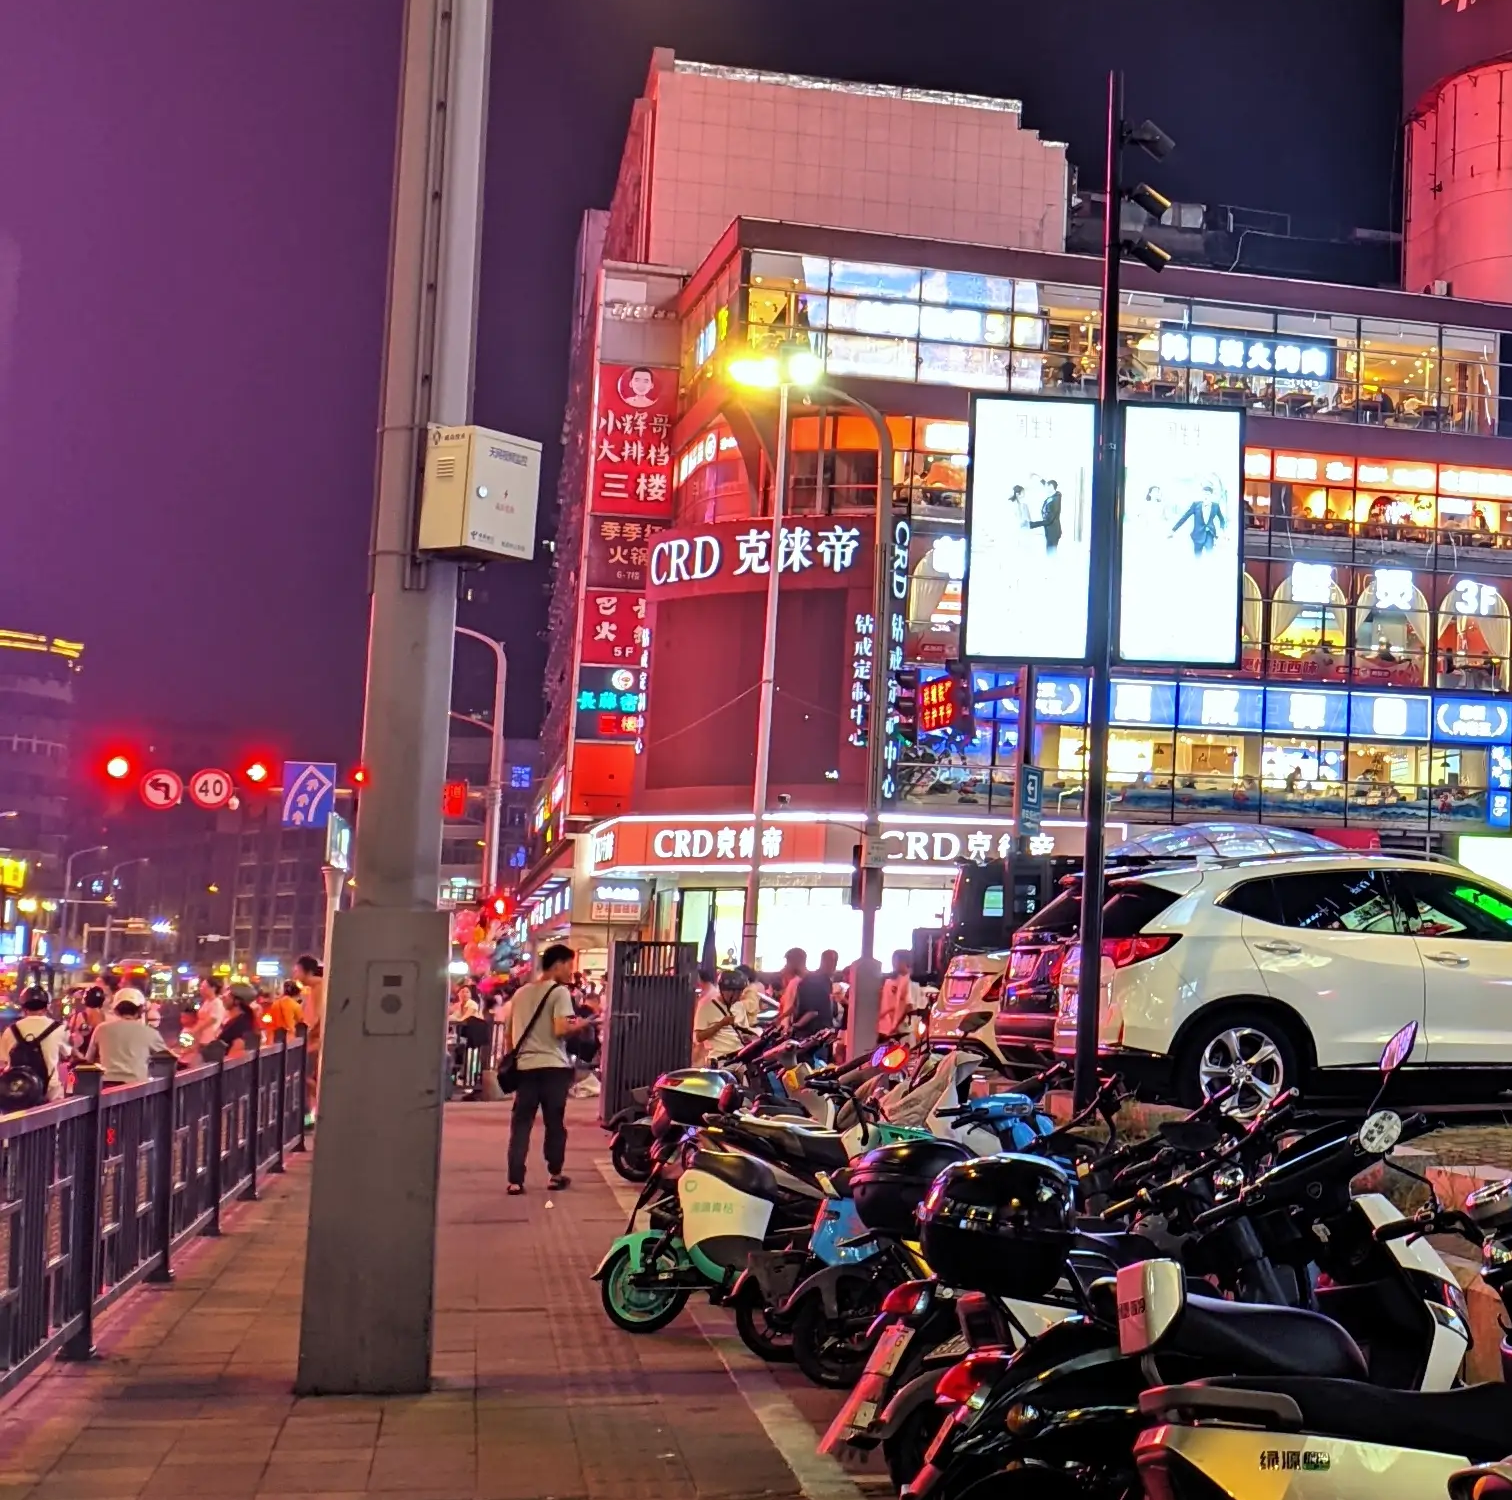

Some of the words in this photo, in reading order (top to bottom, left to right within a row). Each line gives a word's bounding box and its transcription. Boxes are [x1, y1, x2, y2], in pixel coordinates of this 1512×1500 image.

[598, 409, 672, 439] 小辉哥
[597, 439, 670, 467] 大排档
[600, 472, 668, 502] 三楼
[608, 546, 649, 567] 火锅
[650, 535, 720, 586] CRD
[892, 520, 910, 600] CRD
[1455, 579, 1498, 616] 3F
[613, 646, 634, 658] 5F
[848, 613, 875, 747] 钻戒定制中心
[197, 778, 224, 798] 40
[1259, 1450, 1301, 1471] 绿源
